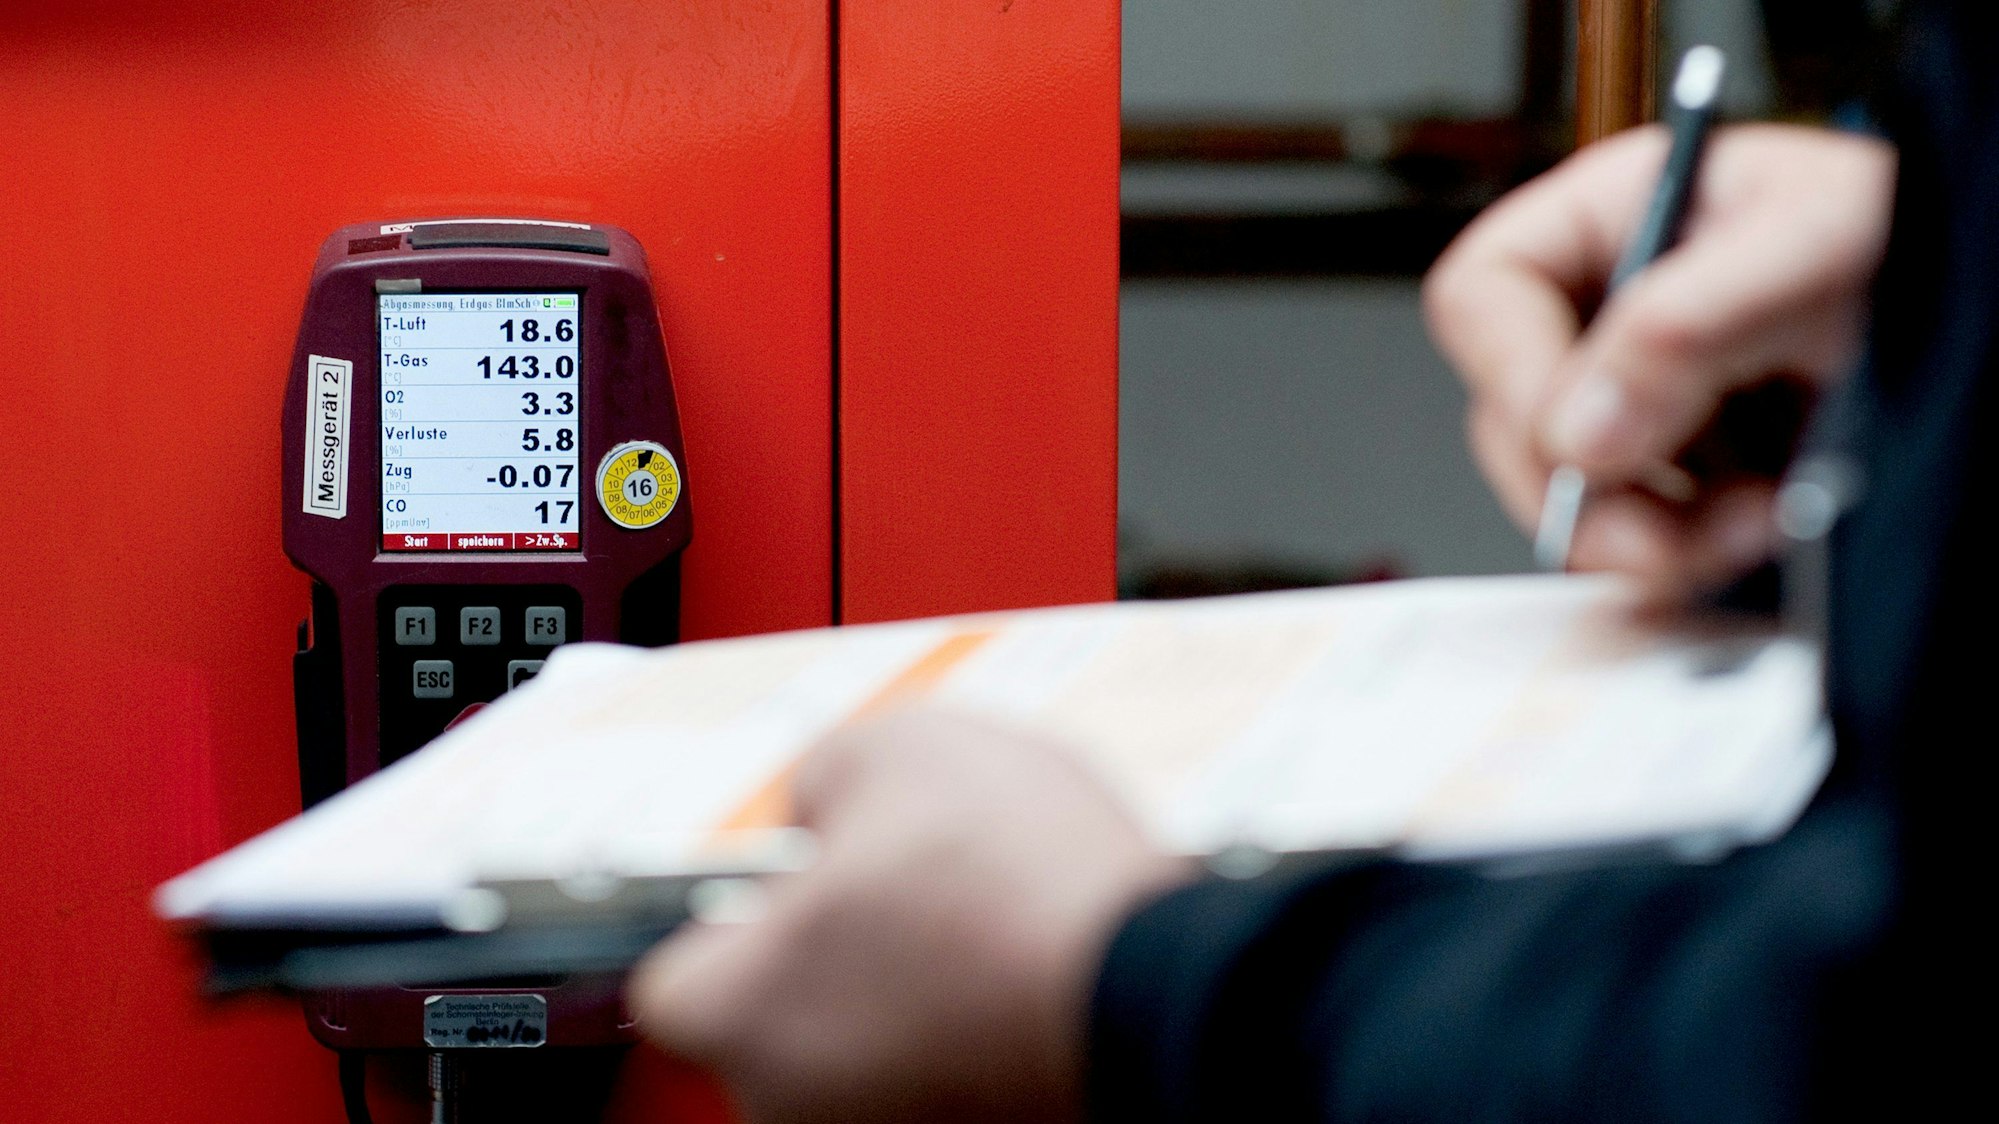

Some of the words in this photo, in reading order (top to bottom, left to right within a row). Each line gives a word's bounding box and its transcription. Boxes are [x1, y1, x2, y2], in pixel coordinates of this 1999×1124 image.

[460, 298, 493, 310] Erdgas
[384, 317, 426, 330] T-Luft
[500, 319, 574, 342] 18.6
[384, 354, 428, 367] T-Gas
[477, 355, 574, 379] 143.0
[323, 371, 339, 384] 2
[385, 390, 404, 403] O2
[521, 392, 574, 415] 3.3
[385, 426, 447, 440] Verluste
[522, 428, 574, 452] 5.8
[318, 392, 339, 502] Messgerät
[626, 458, 637, 467] 12
[653, 461, 665, 471] 02
[386, 463, 412, 479] Zug
[487, 465, 574, 488] -0.07
[615, 467, 624, 475] 11
[661, 473, 673, 482] 03
[608, 480, 619, 489] 10
[628, 478, 652, 498] 16
[608, 493, 620, 502] 09
[661, 487, 673, 496] 04
[616, 505, 627, 514] 08
[655, 501, 667, 509] 05
[386, 499, 406, 512] CO
[535, 501, 574, 524] 17
[629, 511, 640, 519] 07
[643, 508, 655, 517] 06
[405, 535, 428, 547] Start
[458, 535, 504, 549] speichern
[405, 617, 426, 635] F1
[468, 617, 493, 635] F2
[533, 617, 558, 635] F3
[417, 671, 450, 688] ESC
[446, 1002, 490, 1011] Technische
[476, 1017, 499, 1025] Berlin
[431, 1028, 450, 1037] Reg.
[453, 1028, 464, 1036] Nr.
